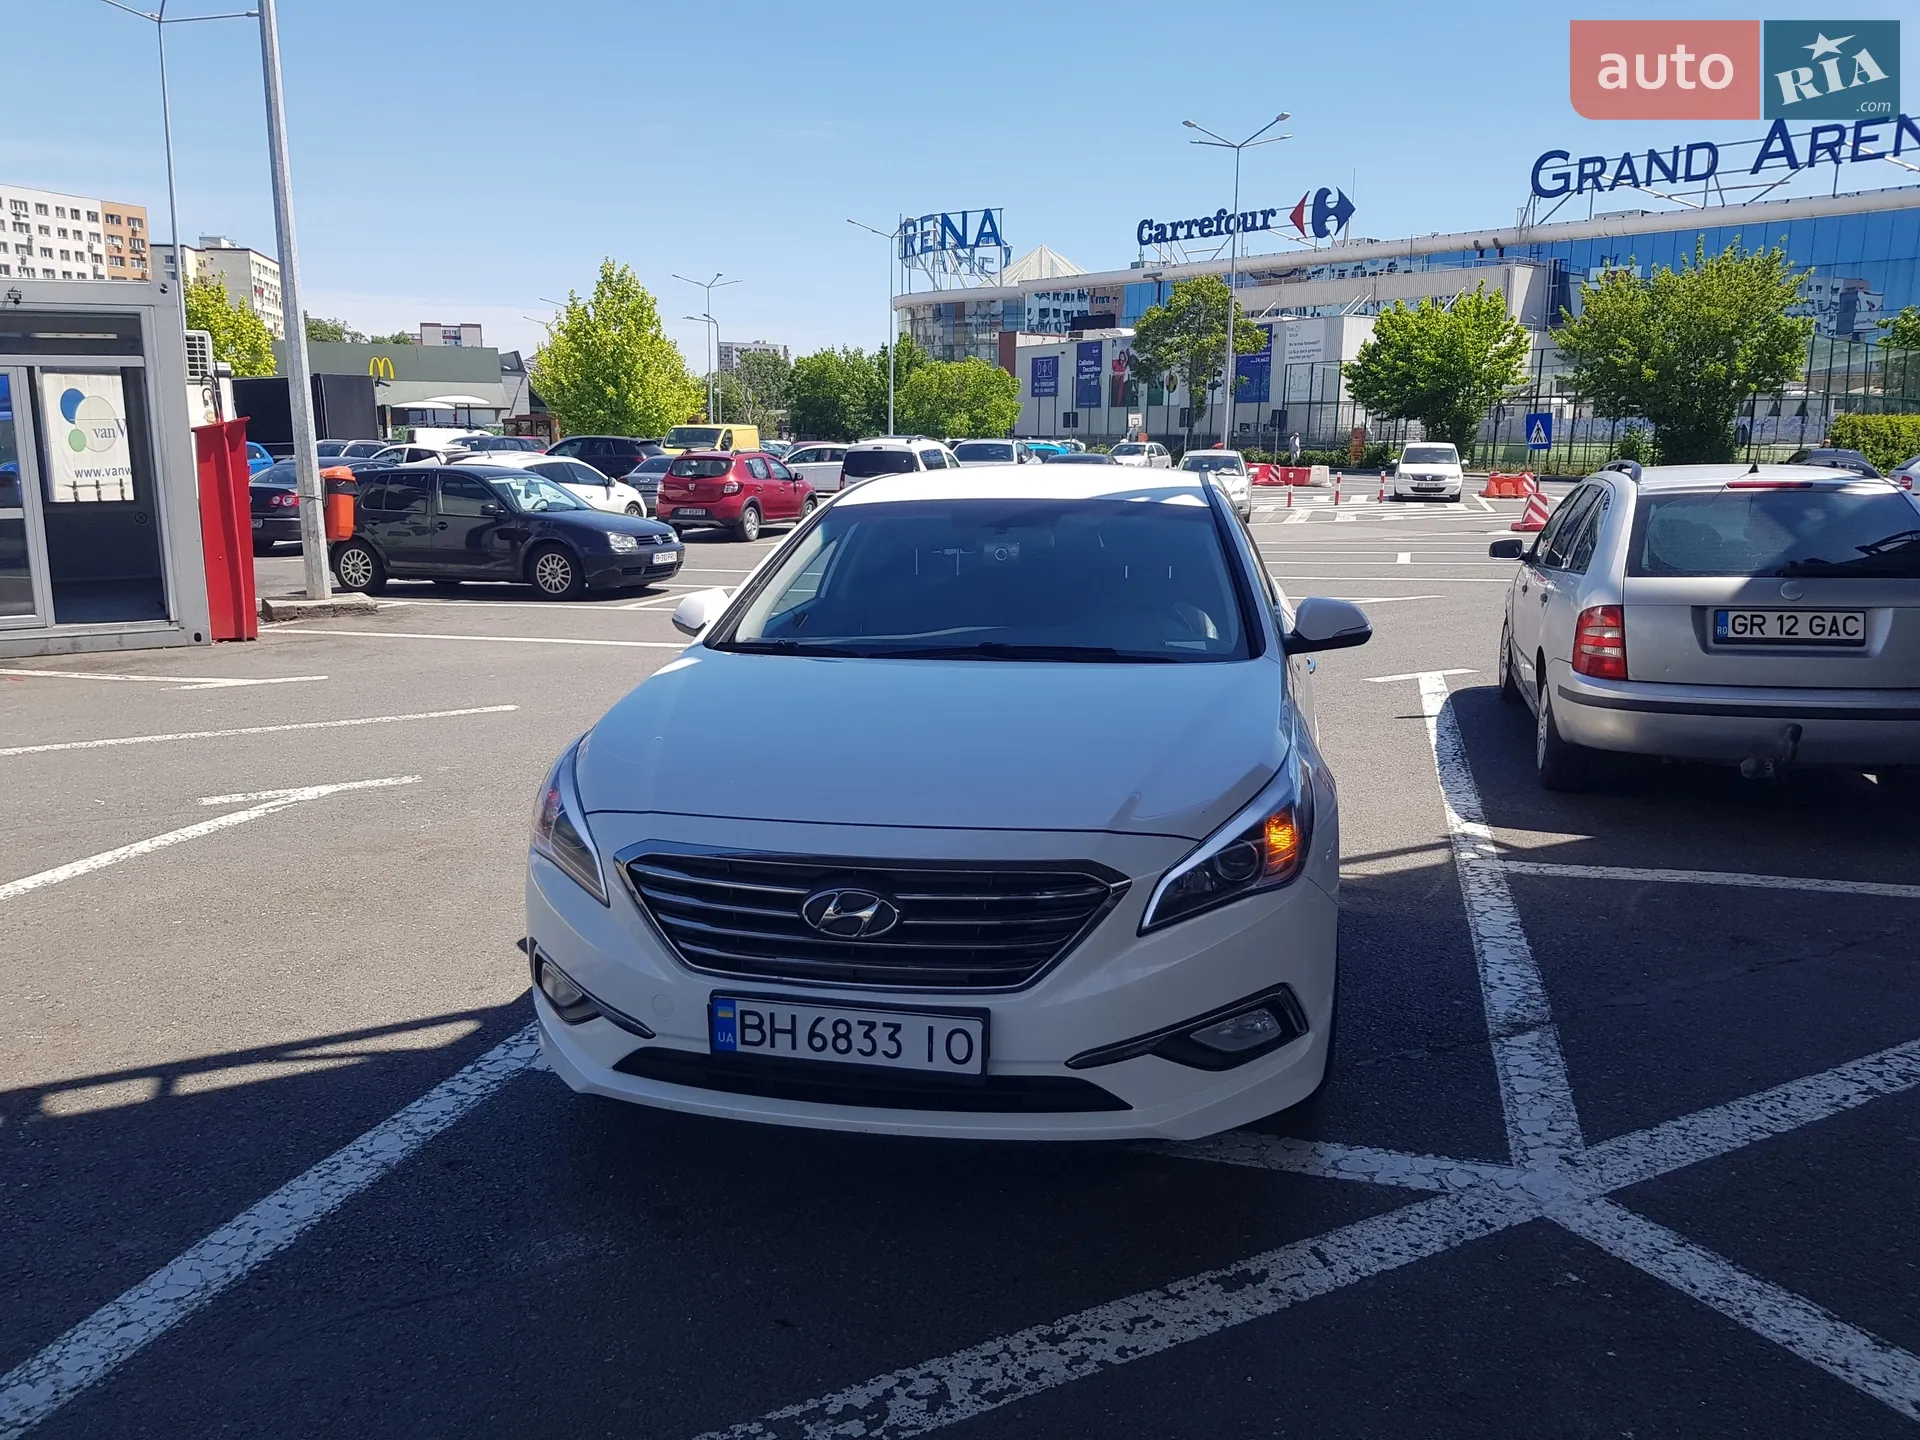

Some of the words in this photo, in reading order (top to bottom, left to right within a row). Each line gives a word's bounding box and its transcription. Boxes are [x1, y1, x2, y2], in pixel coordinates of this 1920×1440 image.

[1531, 141, 1719, 198] GRAND
[1137, 208, 1277, 245] Carrefour
[1717, 626, 1728, 635] RO
[1731, 614, 1766, 635] GR
[1776, 614, 1799, 636] 12
[1809, 615, 1860, 636] GAC
[718, 1032, 735, 1044] UA
[739, 1009, 797, 1050] BH
[807, 1016, 902, 1059] 6833
